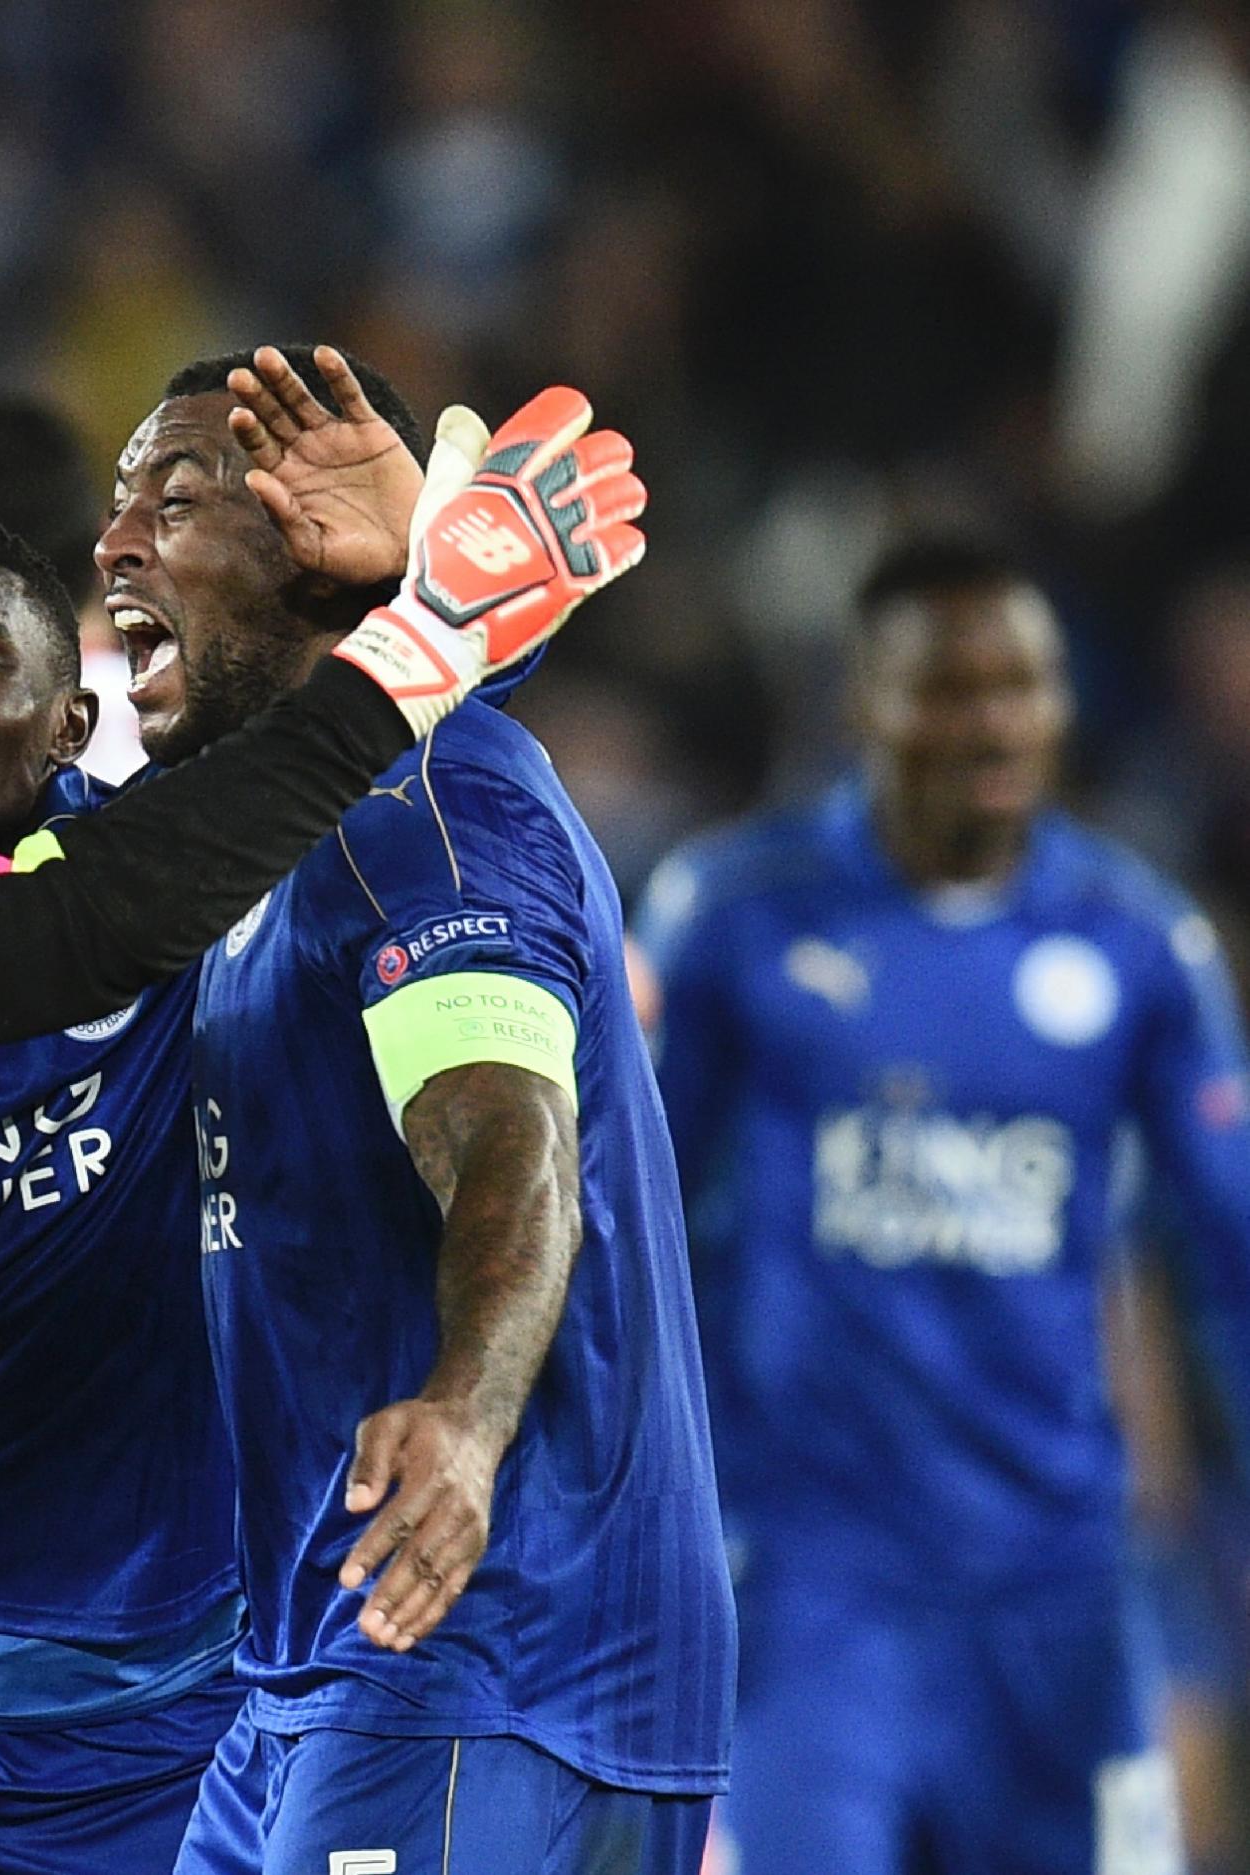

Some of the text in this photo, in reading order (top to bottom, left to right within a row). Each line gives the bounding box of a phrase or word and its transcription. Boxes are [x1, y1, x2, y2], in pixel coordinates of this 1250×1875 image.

[407, 917, 510, 962] RESPECT
[436, 995, 472, 1012] NO
[478, 994, 508, 1008] TO
